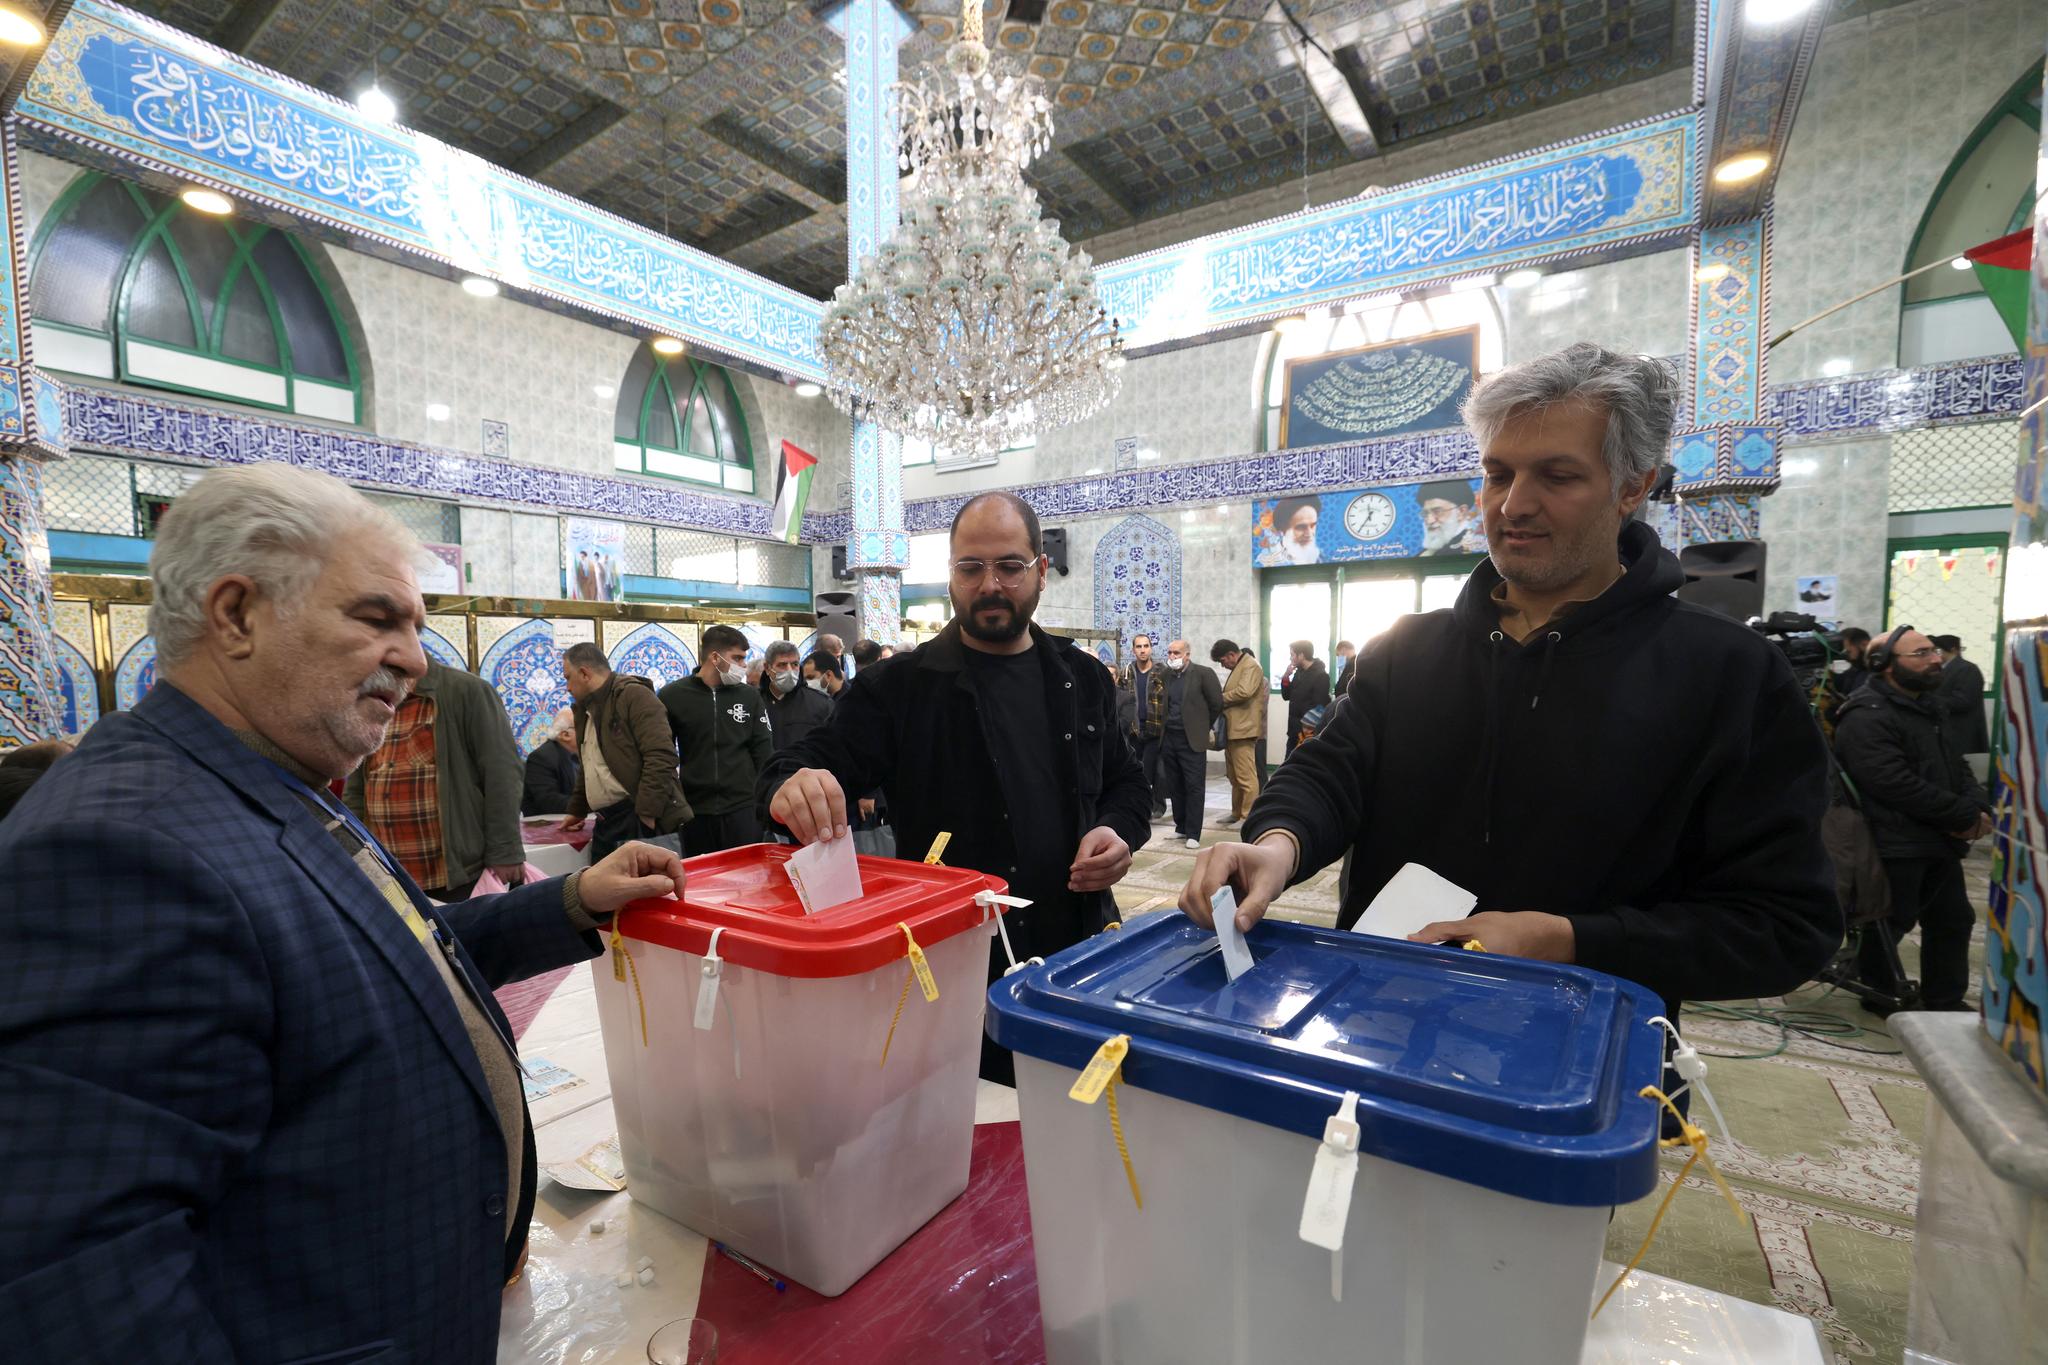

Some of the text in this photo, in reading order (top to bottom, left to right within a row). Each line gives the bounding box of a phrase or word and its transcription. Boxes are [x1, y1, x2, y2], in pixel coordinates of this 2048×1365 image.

[1442, 180, 1520, 257] الرحمن
[1511, 170, 1560, 230] الله
[1533, 160, 1607, 237] بسم
